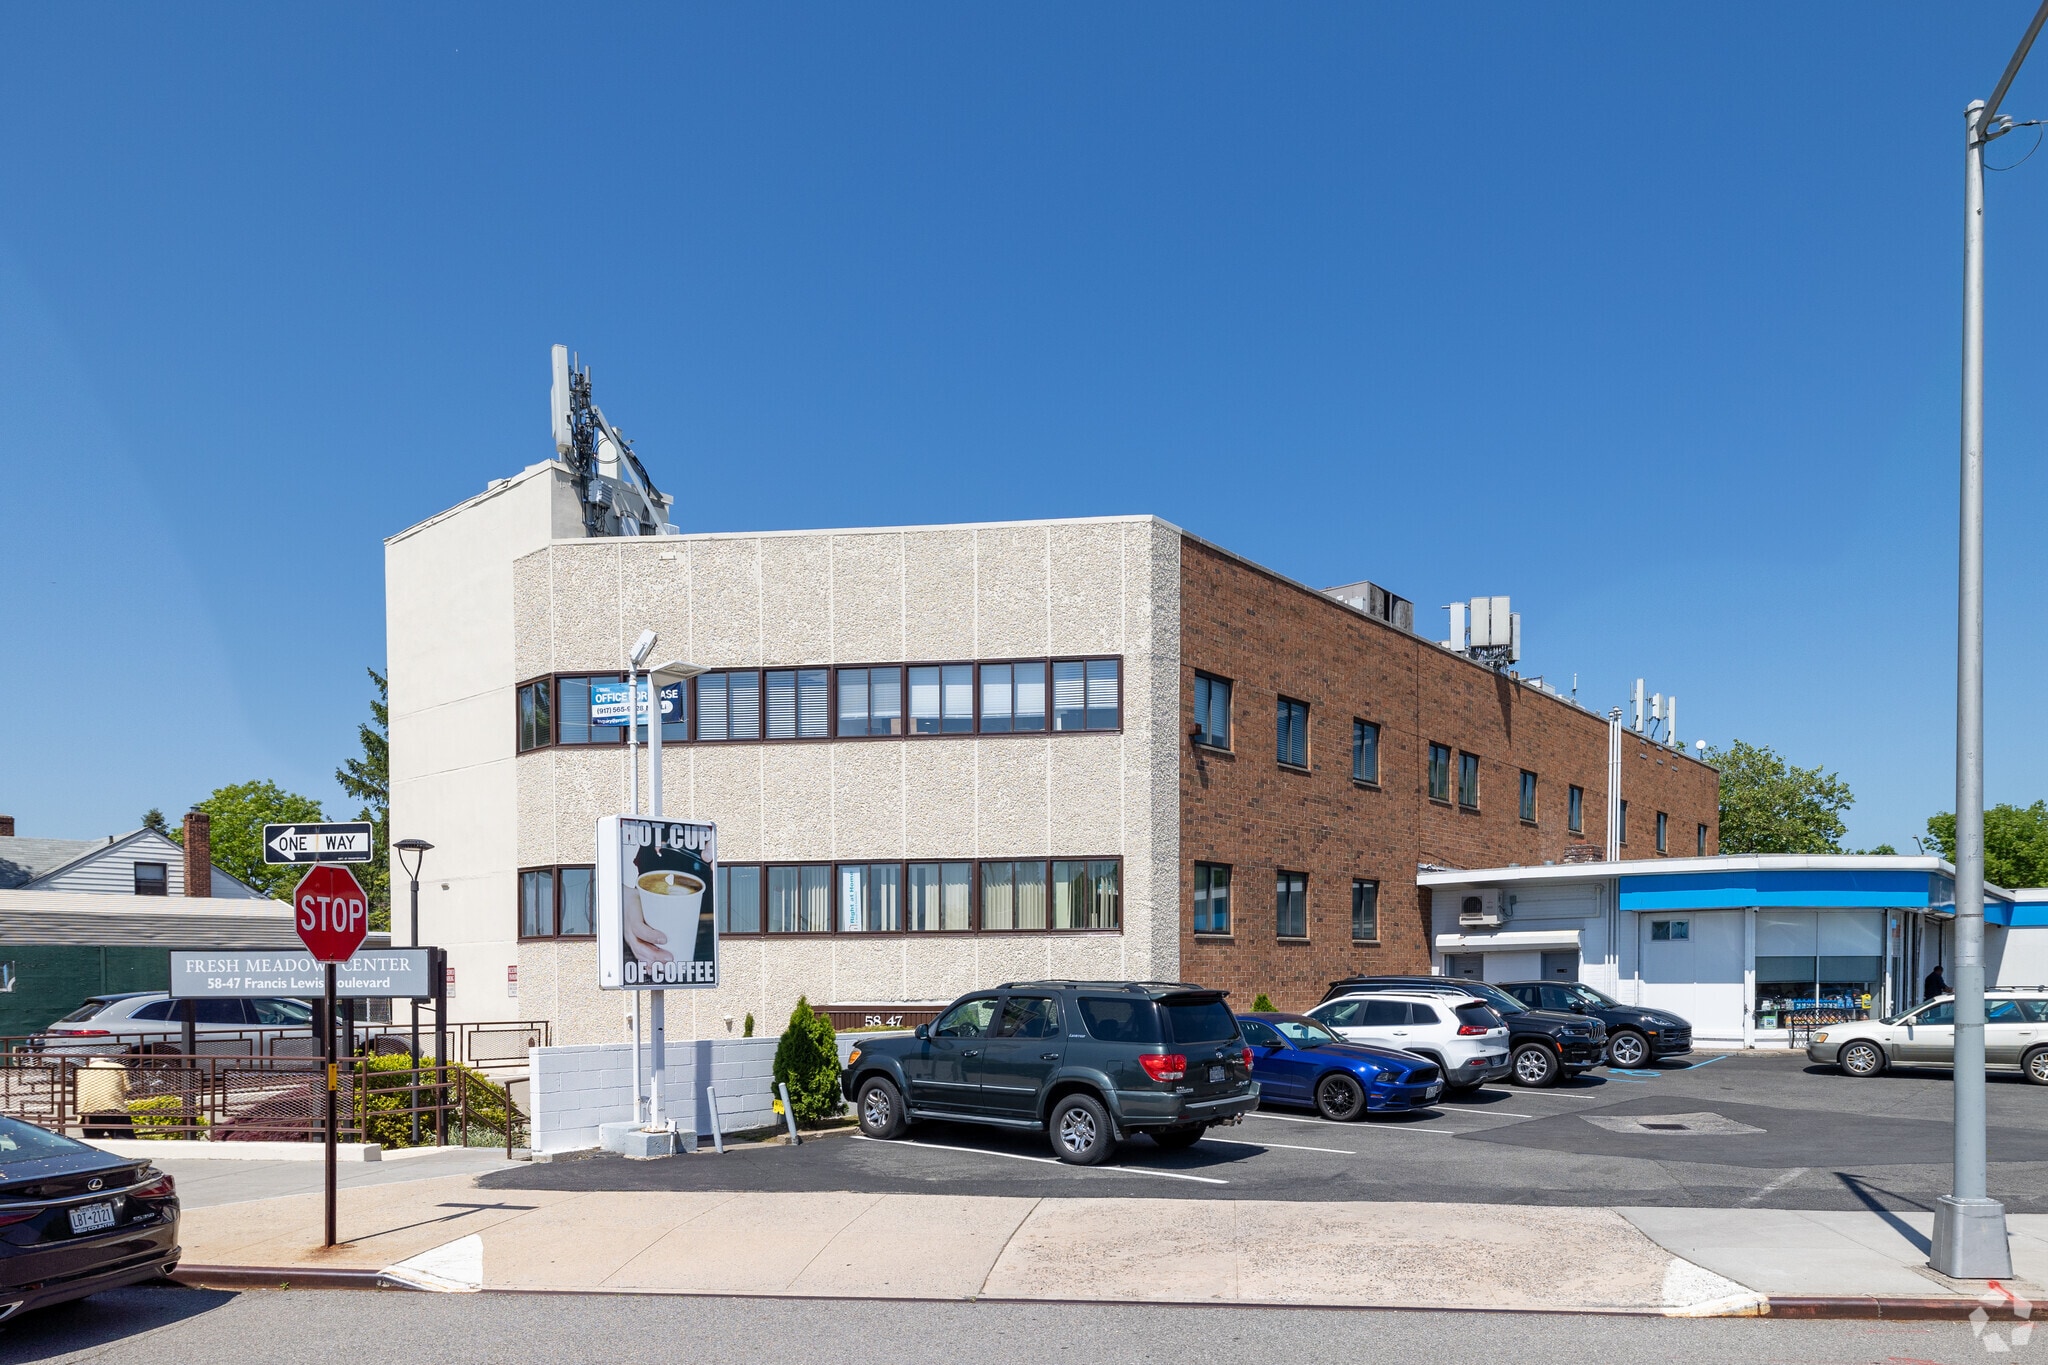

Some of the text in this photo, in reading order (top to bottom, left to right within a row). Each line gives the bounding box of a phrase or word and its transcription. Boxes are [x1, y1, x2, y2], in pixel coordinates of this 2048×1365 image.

[595, 693, 627, 703] OFFICE
[660, 690, 678, 699] ASE
[622, 820, 712, 851] HOT CUP
[279, 836, 355, 851] ONE WAY
[300, 894, 364, 933] STOP
[185, 957, 412, 973] FRESH MEADOW CENTER
[624, 961, 714, 983] OF COFFEE
[207, 976, 391, 989] 58-47 Francis Lewis oulevard
[865, 1015, 903, 1026] 58 47
